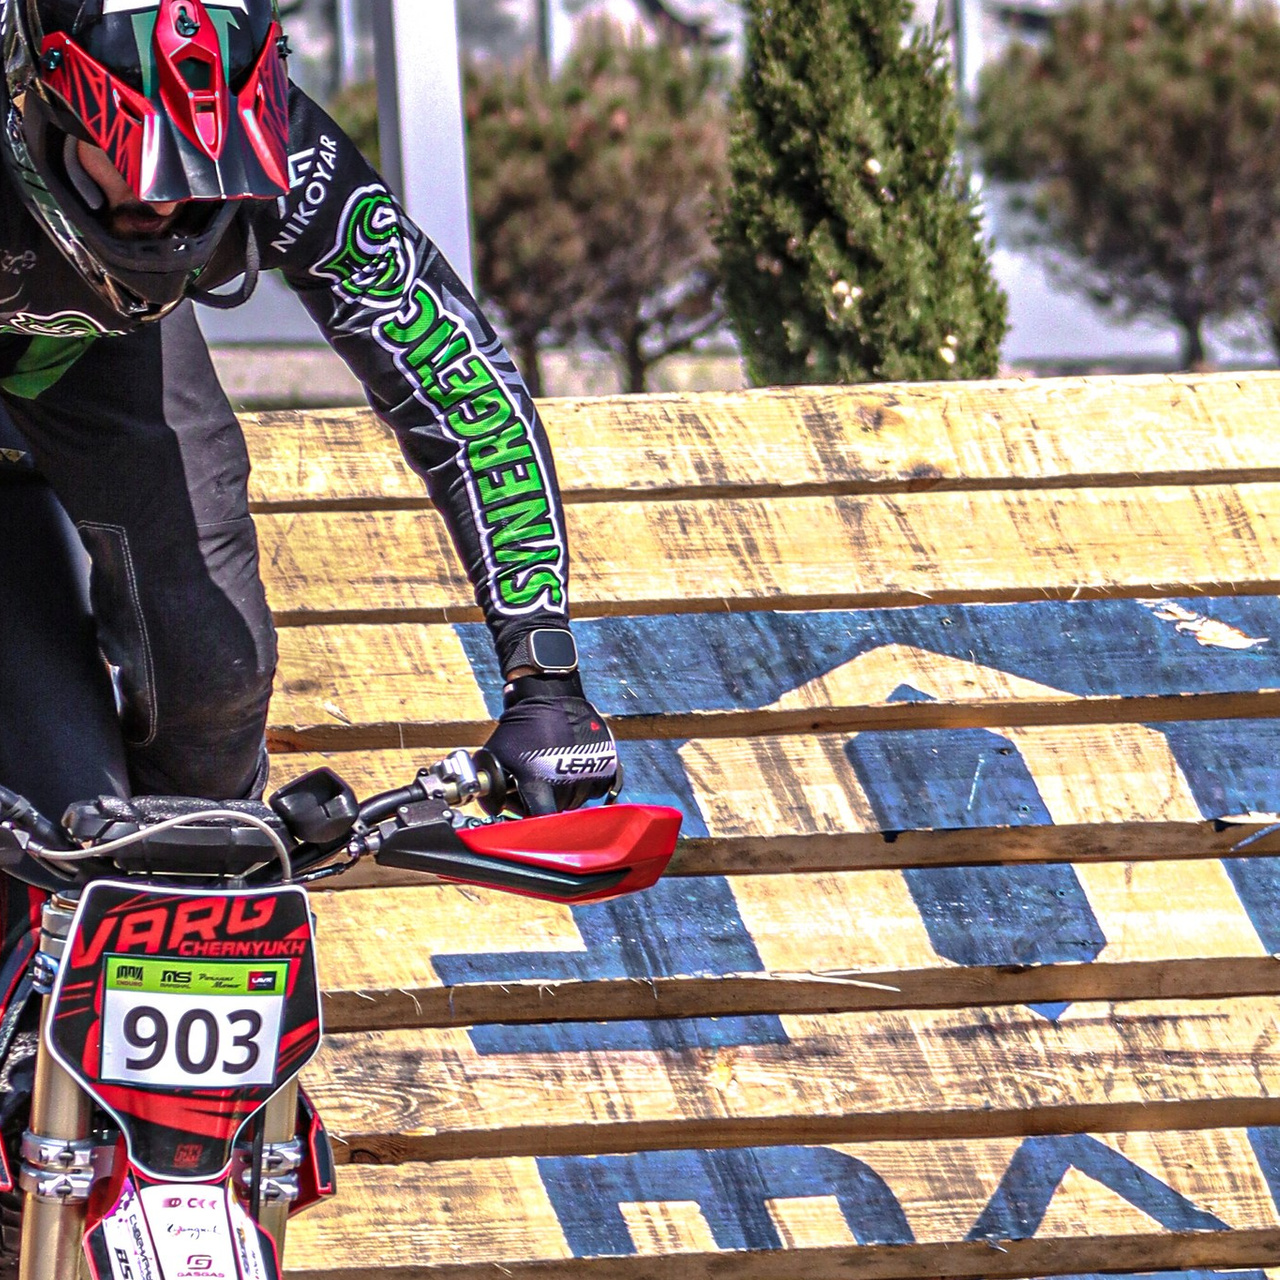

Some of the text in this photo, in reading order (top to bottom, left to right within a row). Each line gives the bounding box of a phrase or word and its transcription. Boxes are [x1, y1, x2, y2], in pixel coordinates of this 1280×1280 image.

[270, 134, 337, 253] NIKOYAR
[377, 282, 563, 611] SYNERGETIC
[554, 755, 616, 775] LEATT
[178, 939, 307, 957] CHERNYUKH
[122, 1005, 263, 1075] 903
